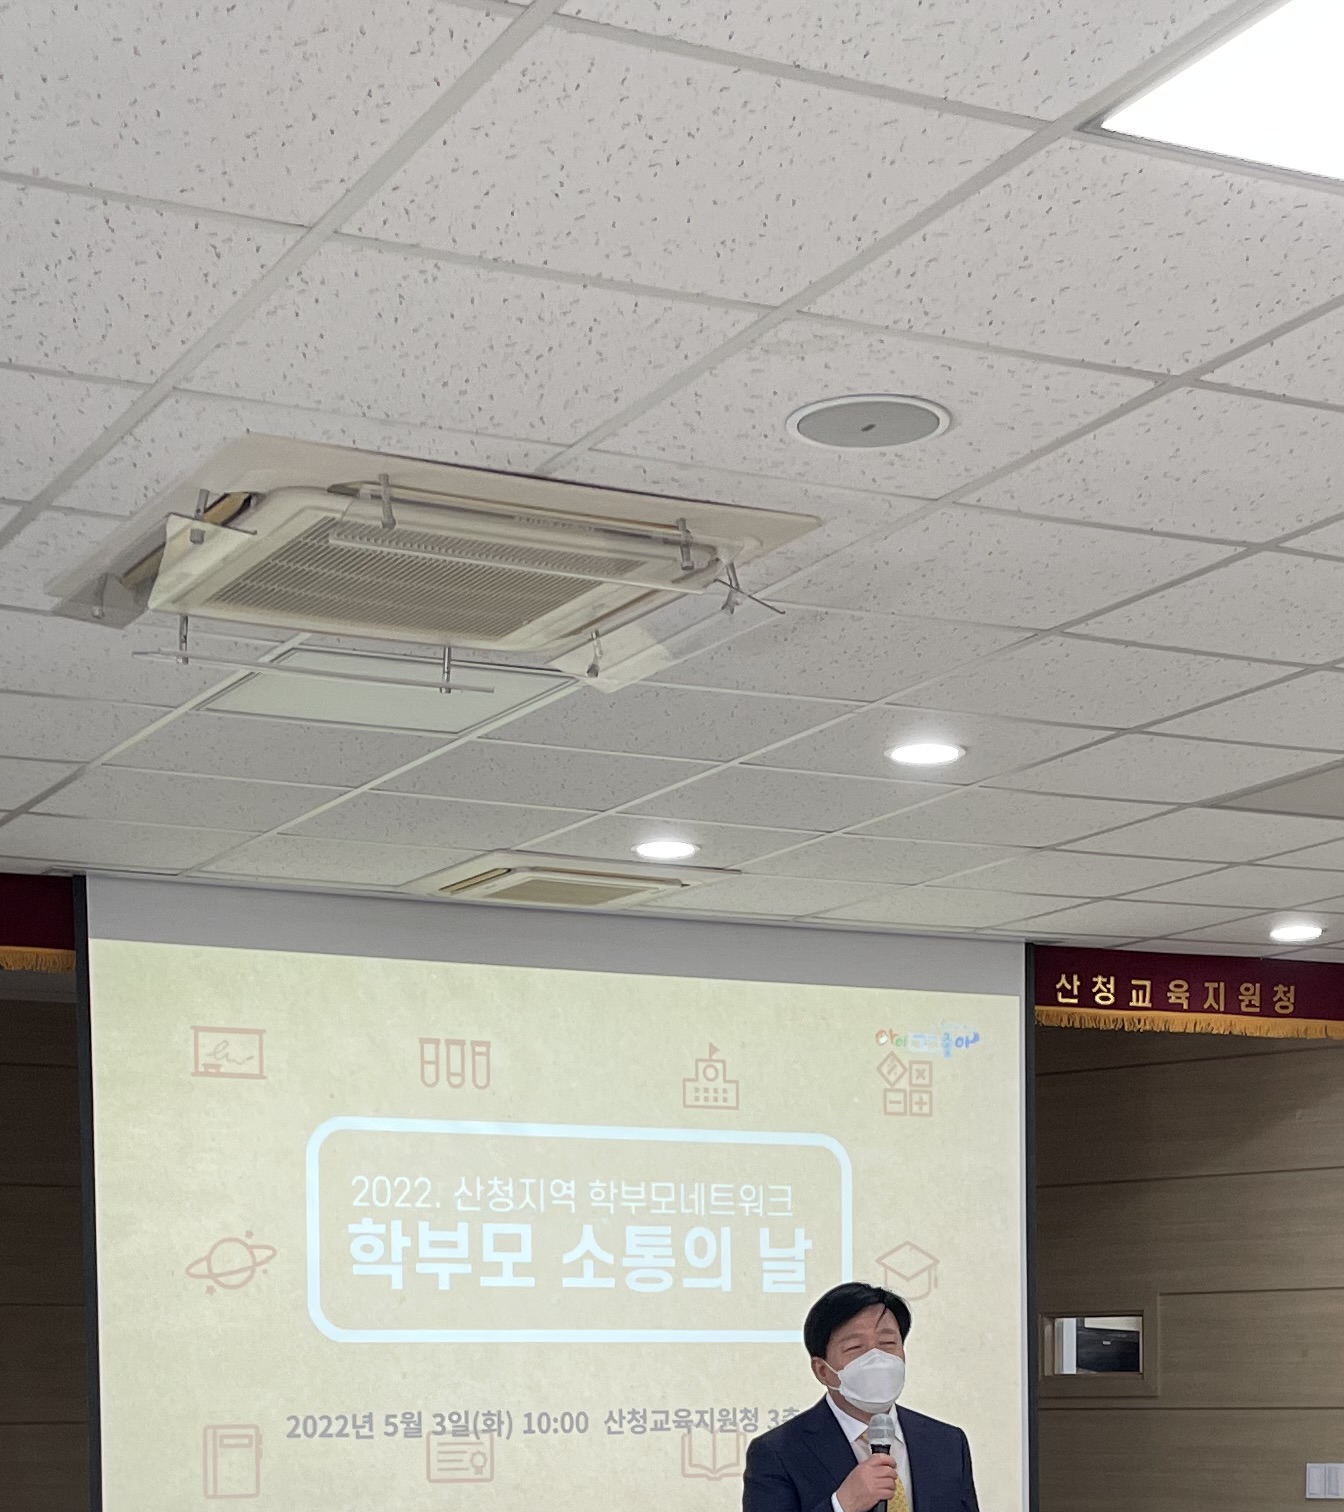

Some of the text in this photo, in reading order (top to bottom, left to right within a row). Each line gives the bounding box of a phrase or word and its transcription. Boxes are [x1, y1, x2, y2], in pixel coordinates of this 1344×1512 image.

[1055, 973, 1298, 1015] 산청교육지원청
[351, 1175, 793, 1217] 2022. 산청지역 학부모네트워크
[347, 1217, 813, 1293] 학부모 소통의 날
[286, 1412, 374, 1439] 2022년
[383, 1411, 423, 1438] 5월
[431, 1410, 513, 1440] 3일(화)
[522, 1412, 589, 1435] 10:00
[604, 1407, 759, 1435] 산청교육지원청
